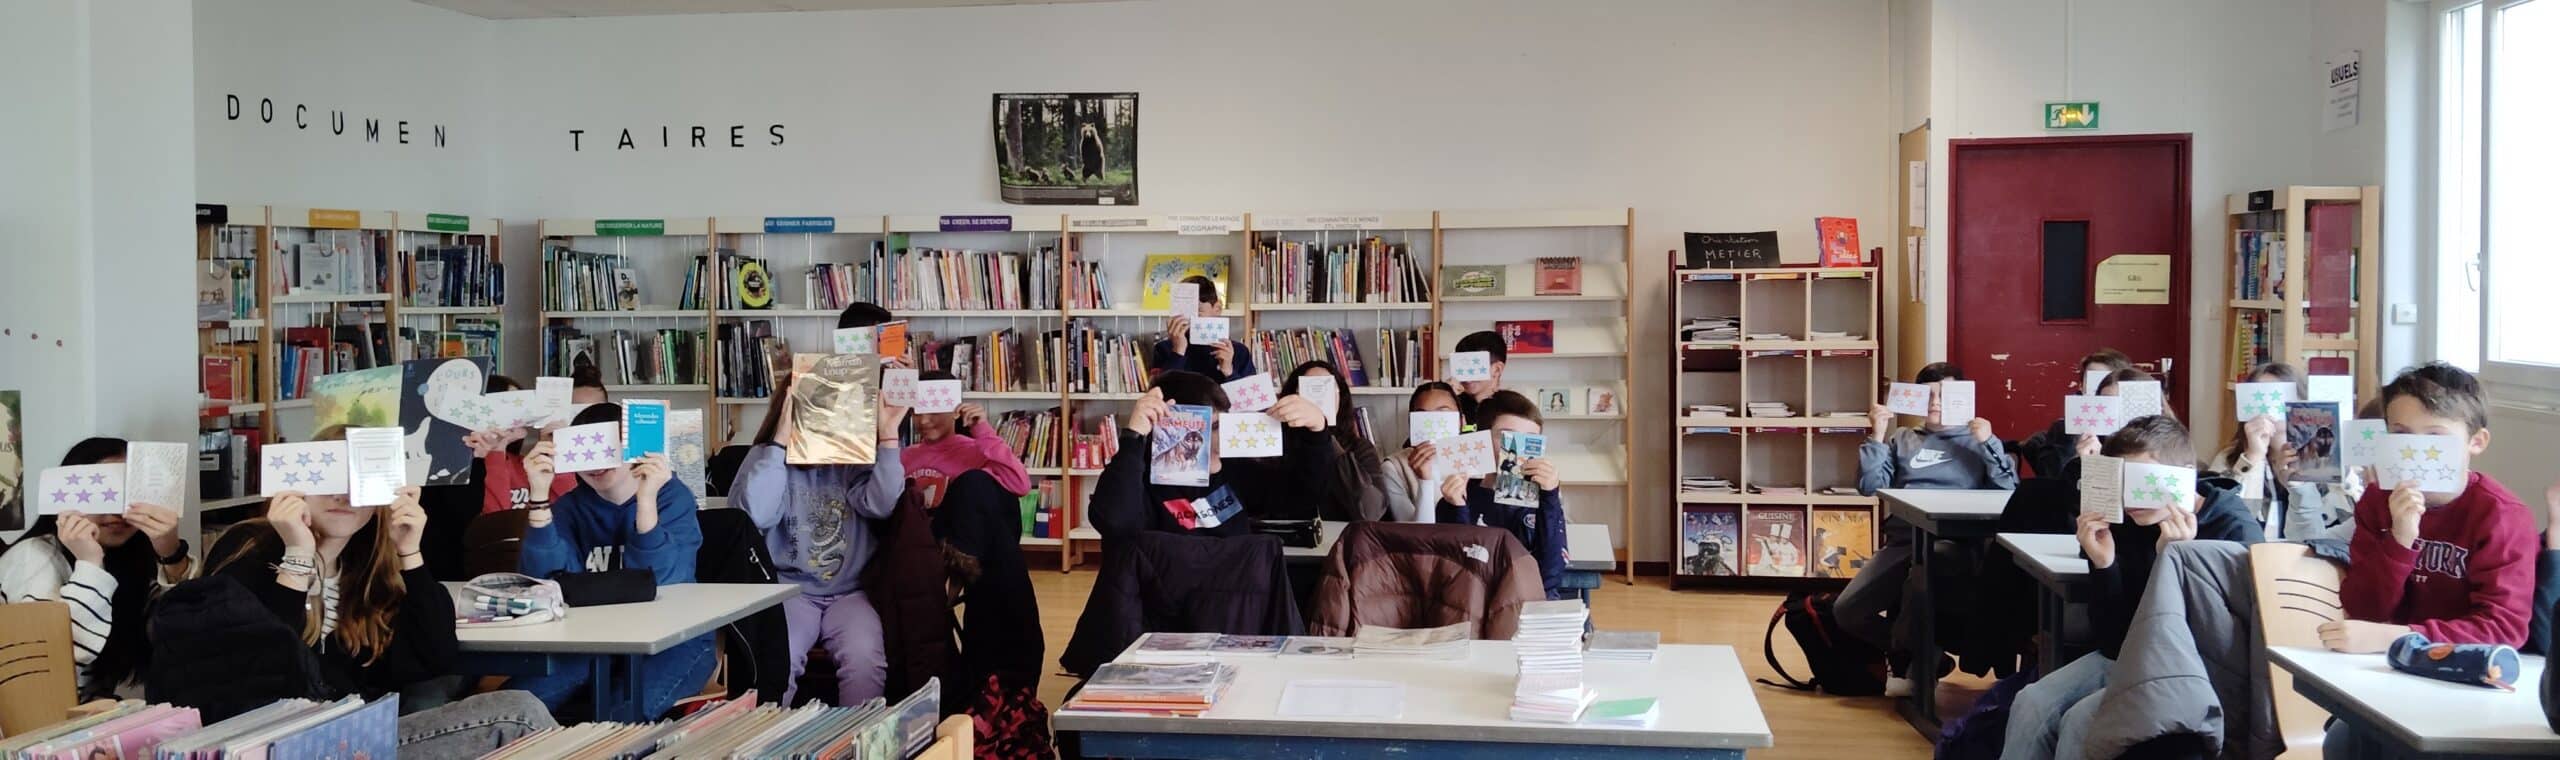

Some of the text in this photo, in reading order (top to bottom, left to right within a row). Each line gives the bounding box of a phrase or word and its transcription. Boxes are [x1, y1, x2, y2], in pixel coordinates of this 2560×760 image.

[226, 93, 785, 152] DOCUMEN TAIRES
[1821, 513, 1865, 523] CINMA
